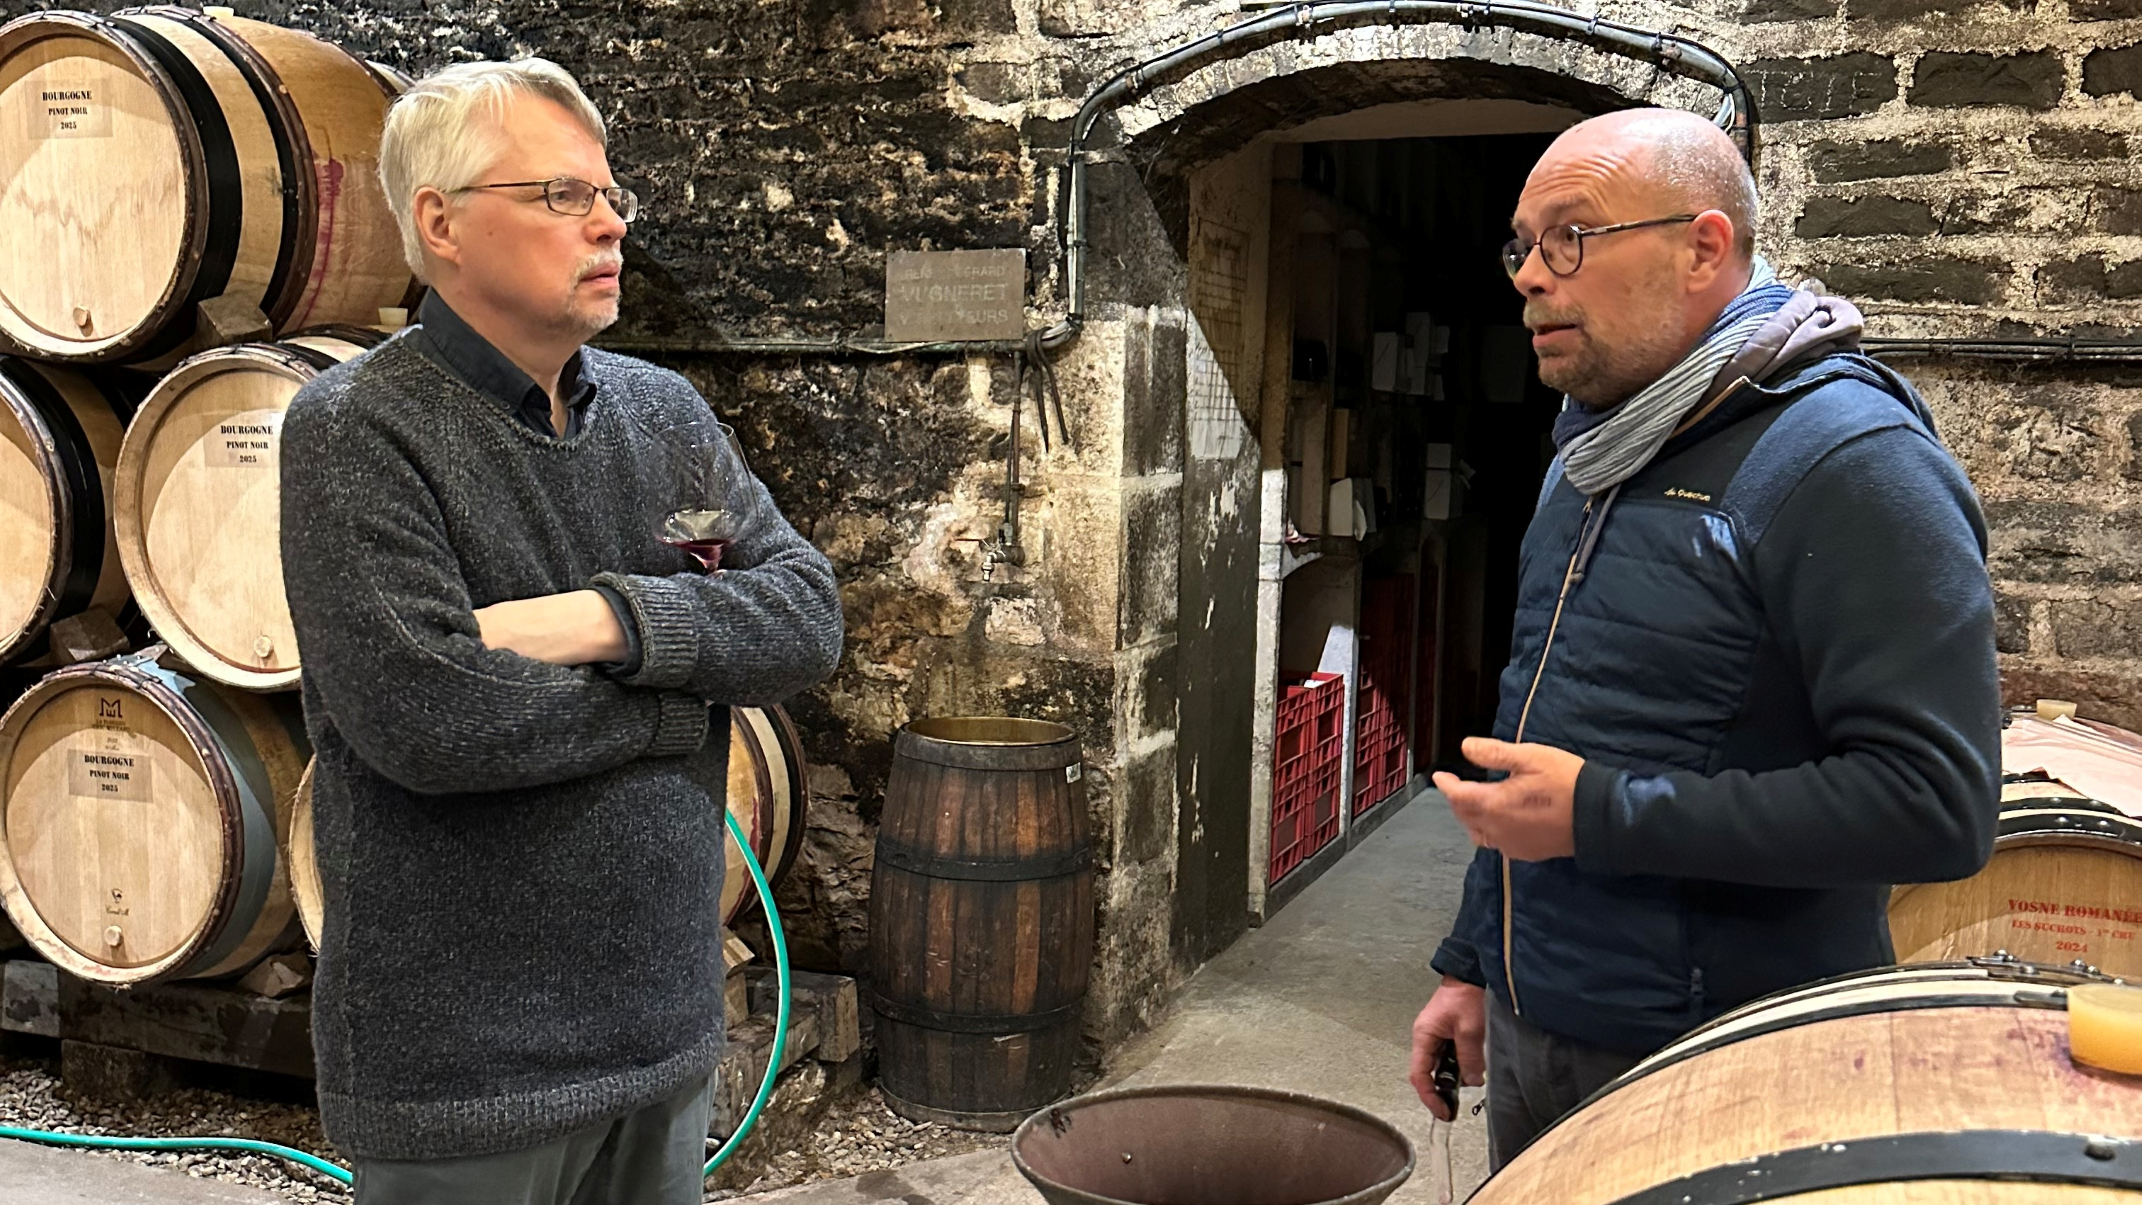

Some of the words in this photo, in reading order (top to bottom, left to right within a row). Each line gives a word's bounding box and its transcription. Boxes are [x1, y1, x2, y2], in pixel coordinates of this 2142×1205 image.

[42, 91, 92, 101] BOURGOGNE
[48, 108, 69, 116] PINOT
[70, 107, 88, 115] NOIR
[60, 121, 77, 130] 2025
[220, 425, 273, 435] BOURGOGNE
[226, 441, 248, 449] PINOT
[250, 441, 269, 449] NOIR
[239, 455, 257, 463] 2025
[84, 754, 135, 767] BOURGOGNE
[89, 769, 110, 780] PINOT
[112, 771, 130, 780] NOIR
[101, 783, 119, 792] 2025
[2008, 899, 2060, 915] VOSNE
[2012, 919, 2031, 930] LES
[2034, 922, 2087, 936] SUCHOTS
[2112, 930, 2135, 941] CRU
[2055, 941, 2088, 953] 2024
